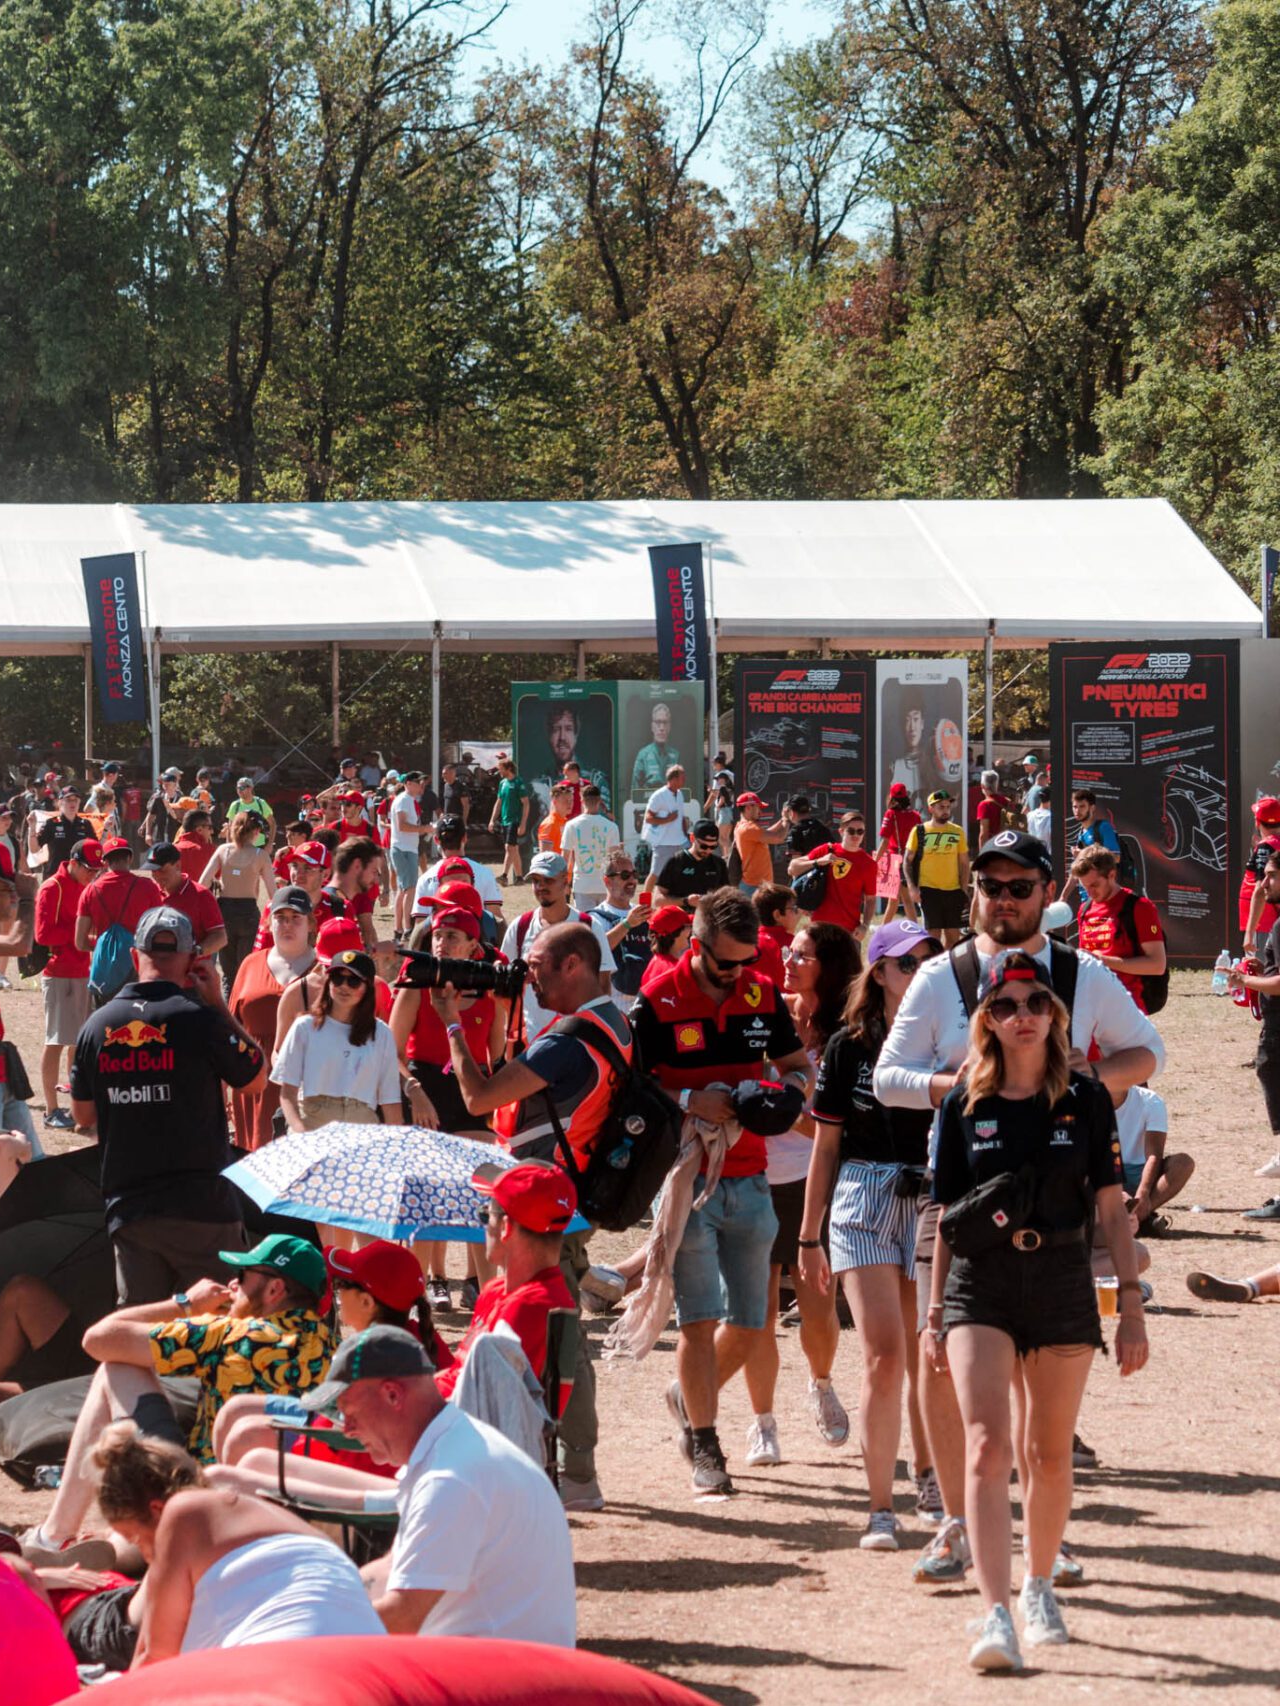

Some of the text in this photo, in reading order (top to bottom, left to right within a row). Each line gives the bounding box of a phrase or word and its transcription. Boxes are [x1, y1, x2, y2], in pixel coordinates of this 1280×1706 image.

[681, 566, 695, 621] CENTO
[667, 567, 686, 658] Fanzone
[100, 577, 123, 698] F1 Fanzone
[113, 577, 133, 698] MONZA CENTO
[1104, 653, 1192, 669] F1 2022
[806, 670, 841, 681] 2022
[748, 692, 861, 701] GRANDI CAMBIAMENTI
[1082, 683, 1207, 700] PNEUMATICI
[749, 702, 861, 713] THE BIG CHANGES
[1110, 702, 1179, 718] TYRES
[98, 1049, 174, 1073] Red Bull
[108, 1085, 151, 1104] Mobil
[972, 1141, 994, 1151] Mobil
